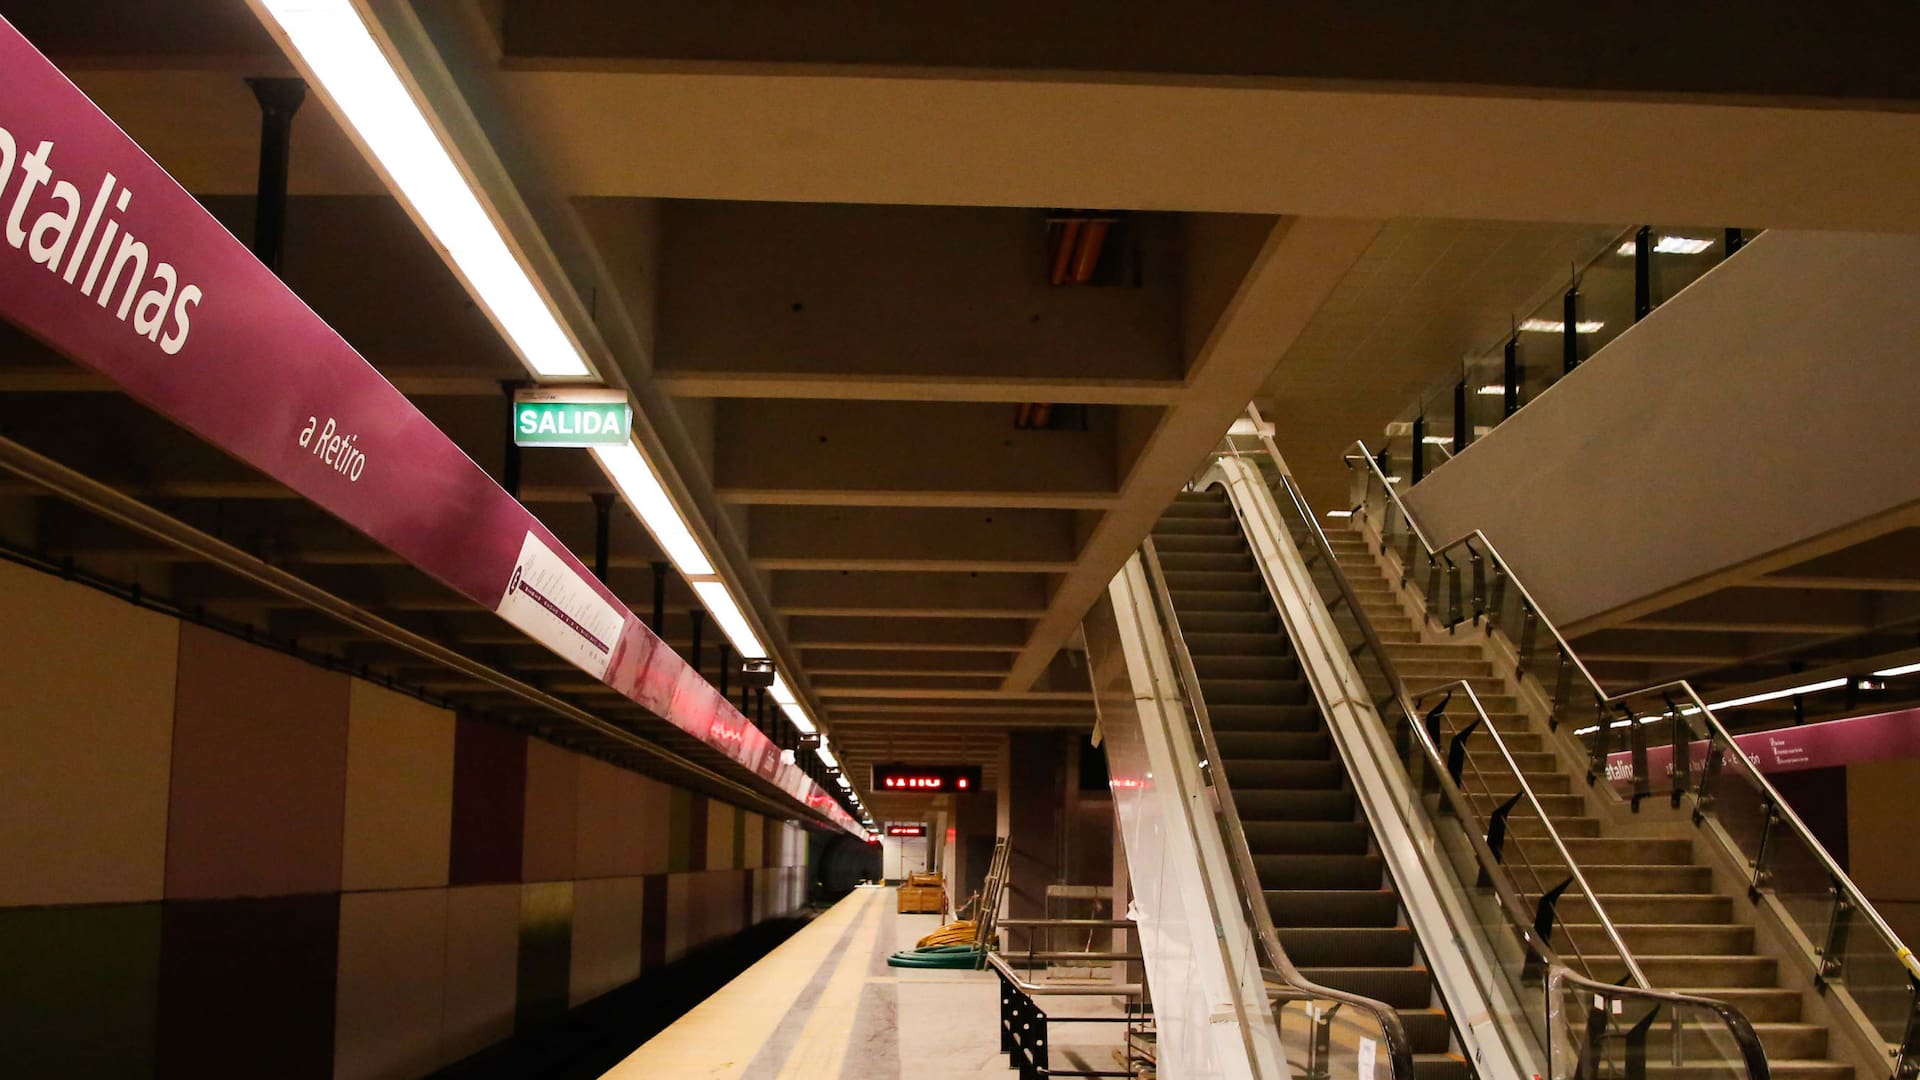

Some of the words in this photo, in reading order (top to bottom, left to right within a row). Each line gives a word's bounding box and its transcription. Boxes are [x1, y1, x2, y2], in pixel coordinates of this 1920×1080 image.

[519, 410, 621, 435] SALIDA
[299, 416, 317, 448] a
[313, 417, 366, 482] Retiro
